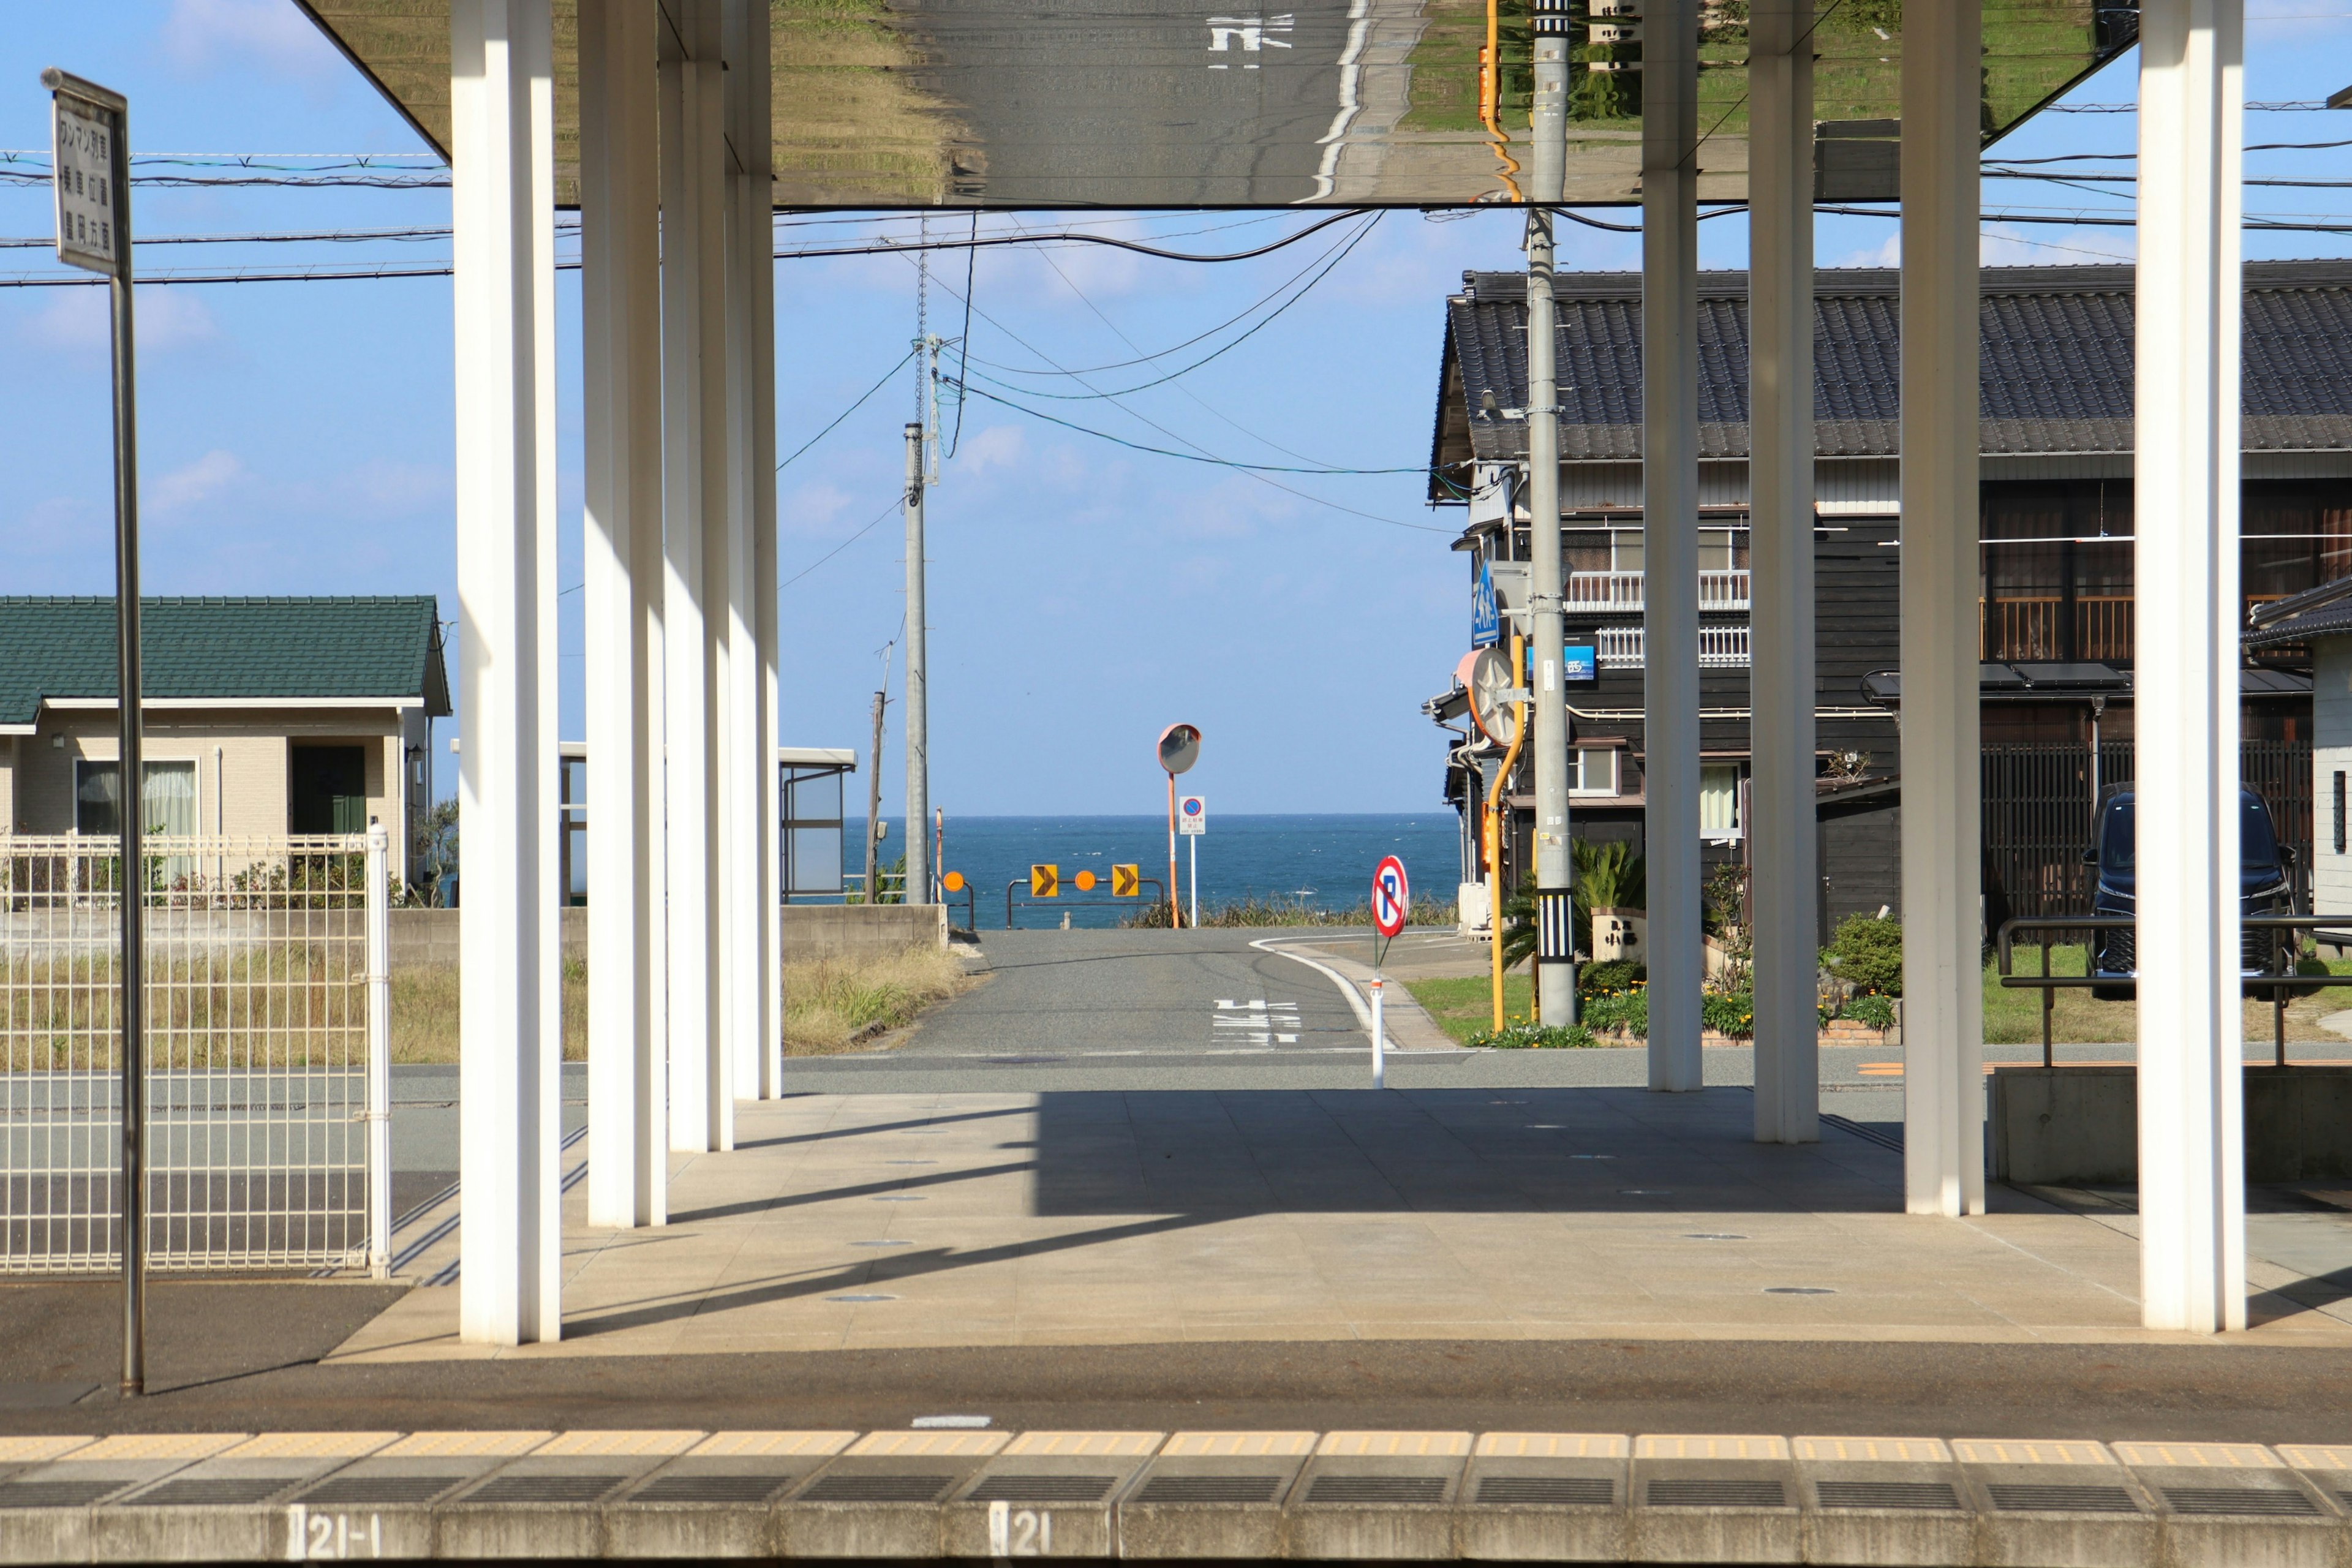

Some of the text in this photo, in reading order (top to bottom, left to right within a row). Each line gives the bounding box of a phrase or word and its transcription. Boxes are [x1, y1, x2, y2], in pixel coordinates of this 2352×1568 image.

[61, 120, 107, 163] ワンマン列車
[63, 165, 108, 207] 乗車位置
[66, 211, 110, 251] 豊岡方面
[307, 1513, 381, 1559] 21-1
[1013, 1510, 1051, 1556] 21
